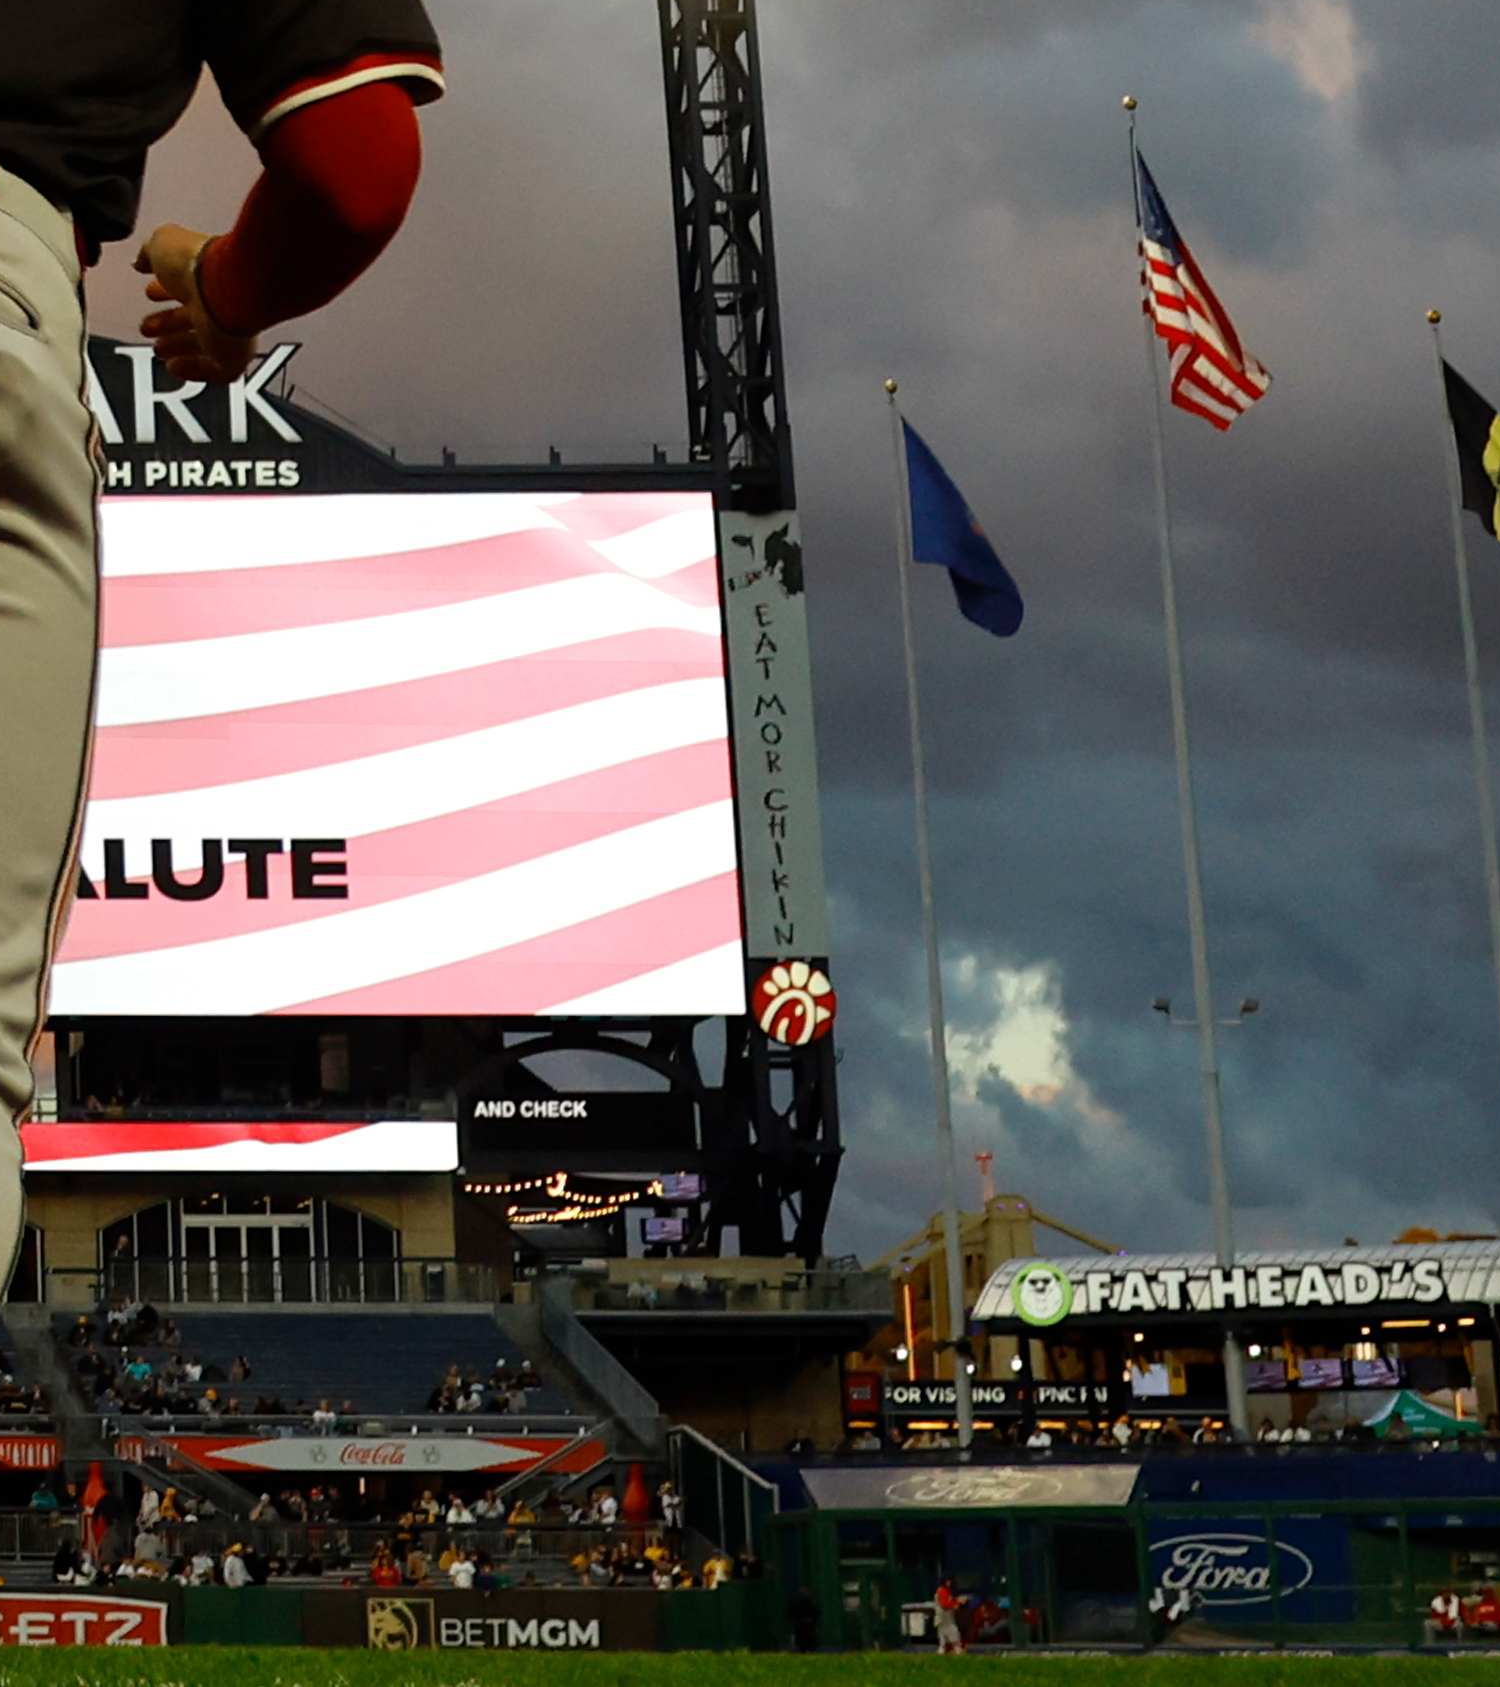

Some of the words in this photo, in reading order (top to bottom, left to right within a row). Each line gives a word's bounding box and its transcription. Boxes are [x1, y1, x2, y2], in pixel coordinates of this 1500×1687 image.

[144, 459, 300, 487] PIRATES
[753, 603, 778, 680] EAT
[753, 693, 787, 774] MOR
[763, 787, 795, 946] CHIKIN
[474, 1100, 516, 1118] AND
[520, 1100, 588, 1118] CHECK
[926, 1386, 1006, 1403] VISING
[440, 1618, 600, 1648] BETMGM
